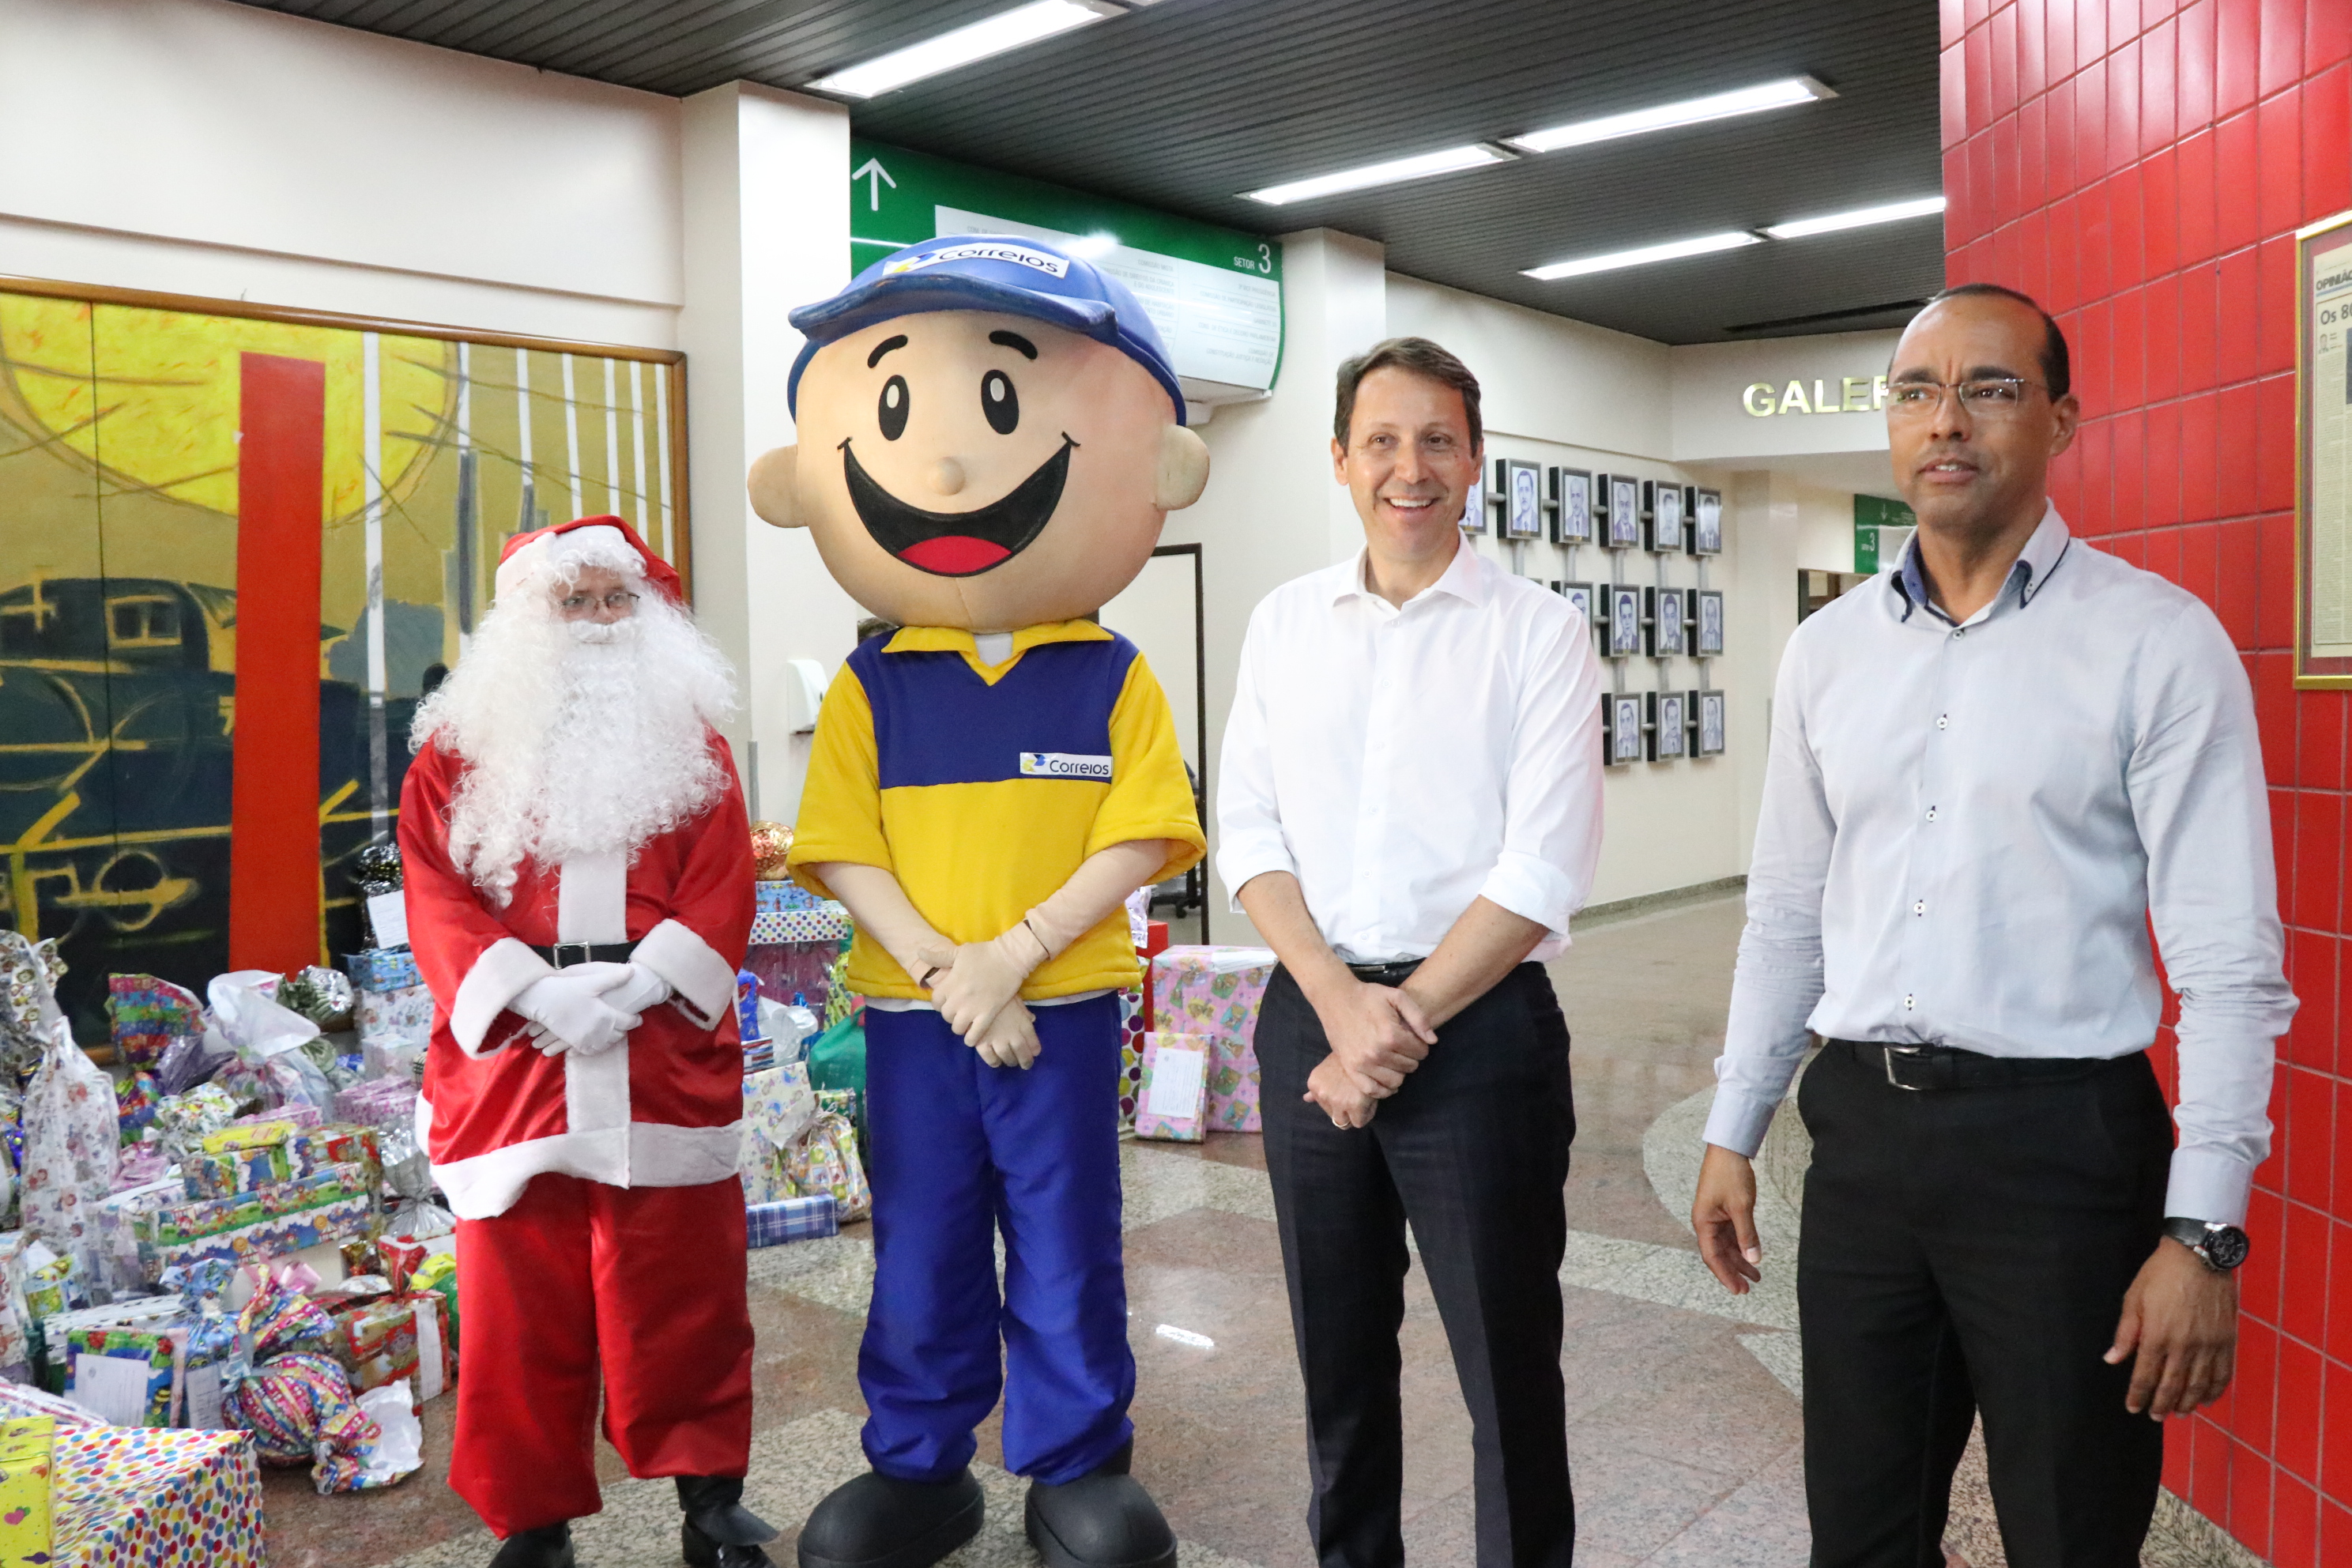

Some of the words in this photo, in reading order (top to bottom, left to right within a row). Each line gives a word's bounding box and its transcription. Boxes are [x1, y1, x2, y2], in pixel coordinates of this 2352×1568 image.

[939, 248, 1058, 273] Correios
[1234, 256, 1255, 270] SETOR
[1258, 243, 1272, 273] 3
[2320, 309, 2337, 325] Os
[1870, 532, 1875, 552] 3
[1050, 760, 1109, 775] Correios
